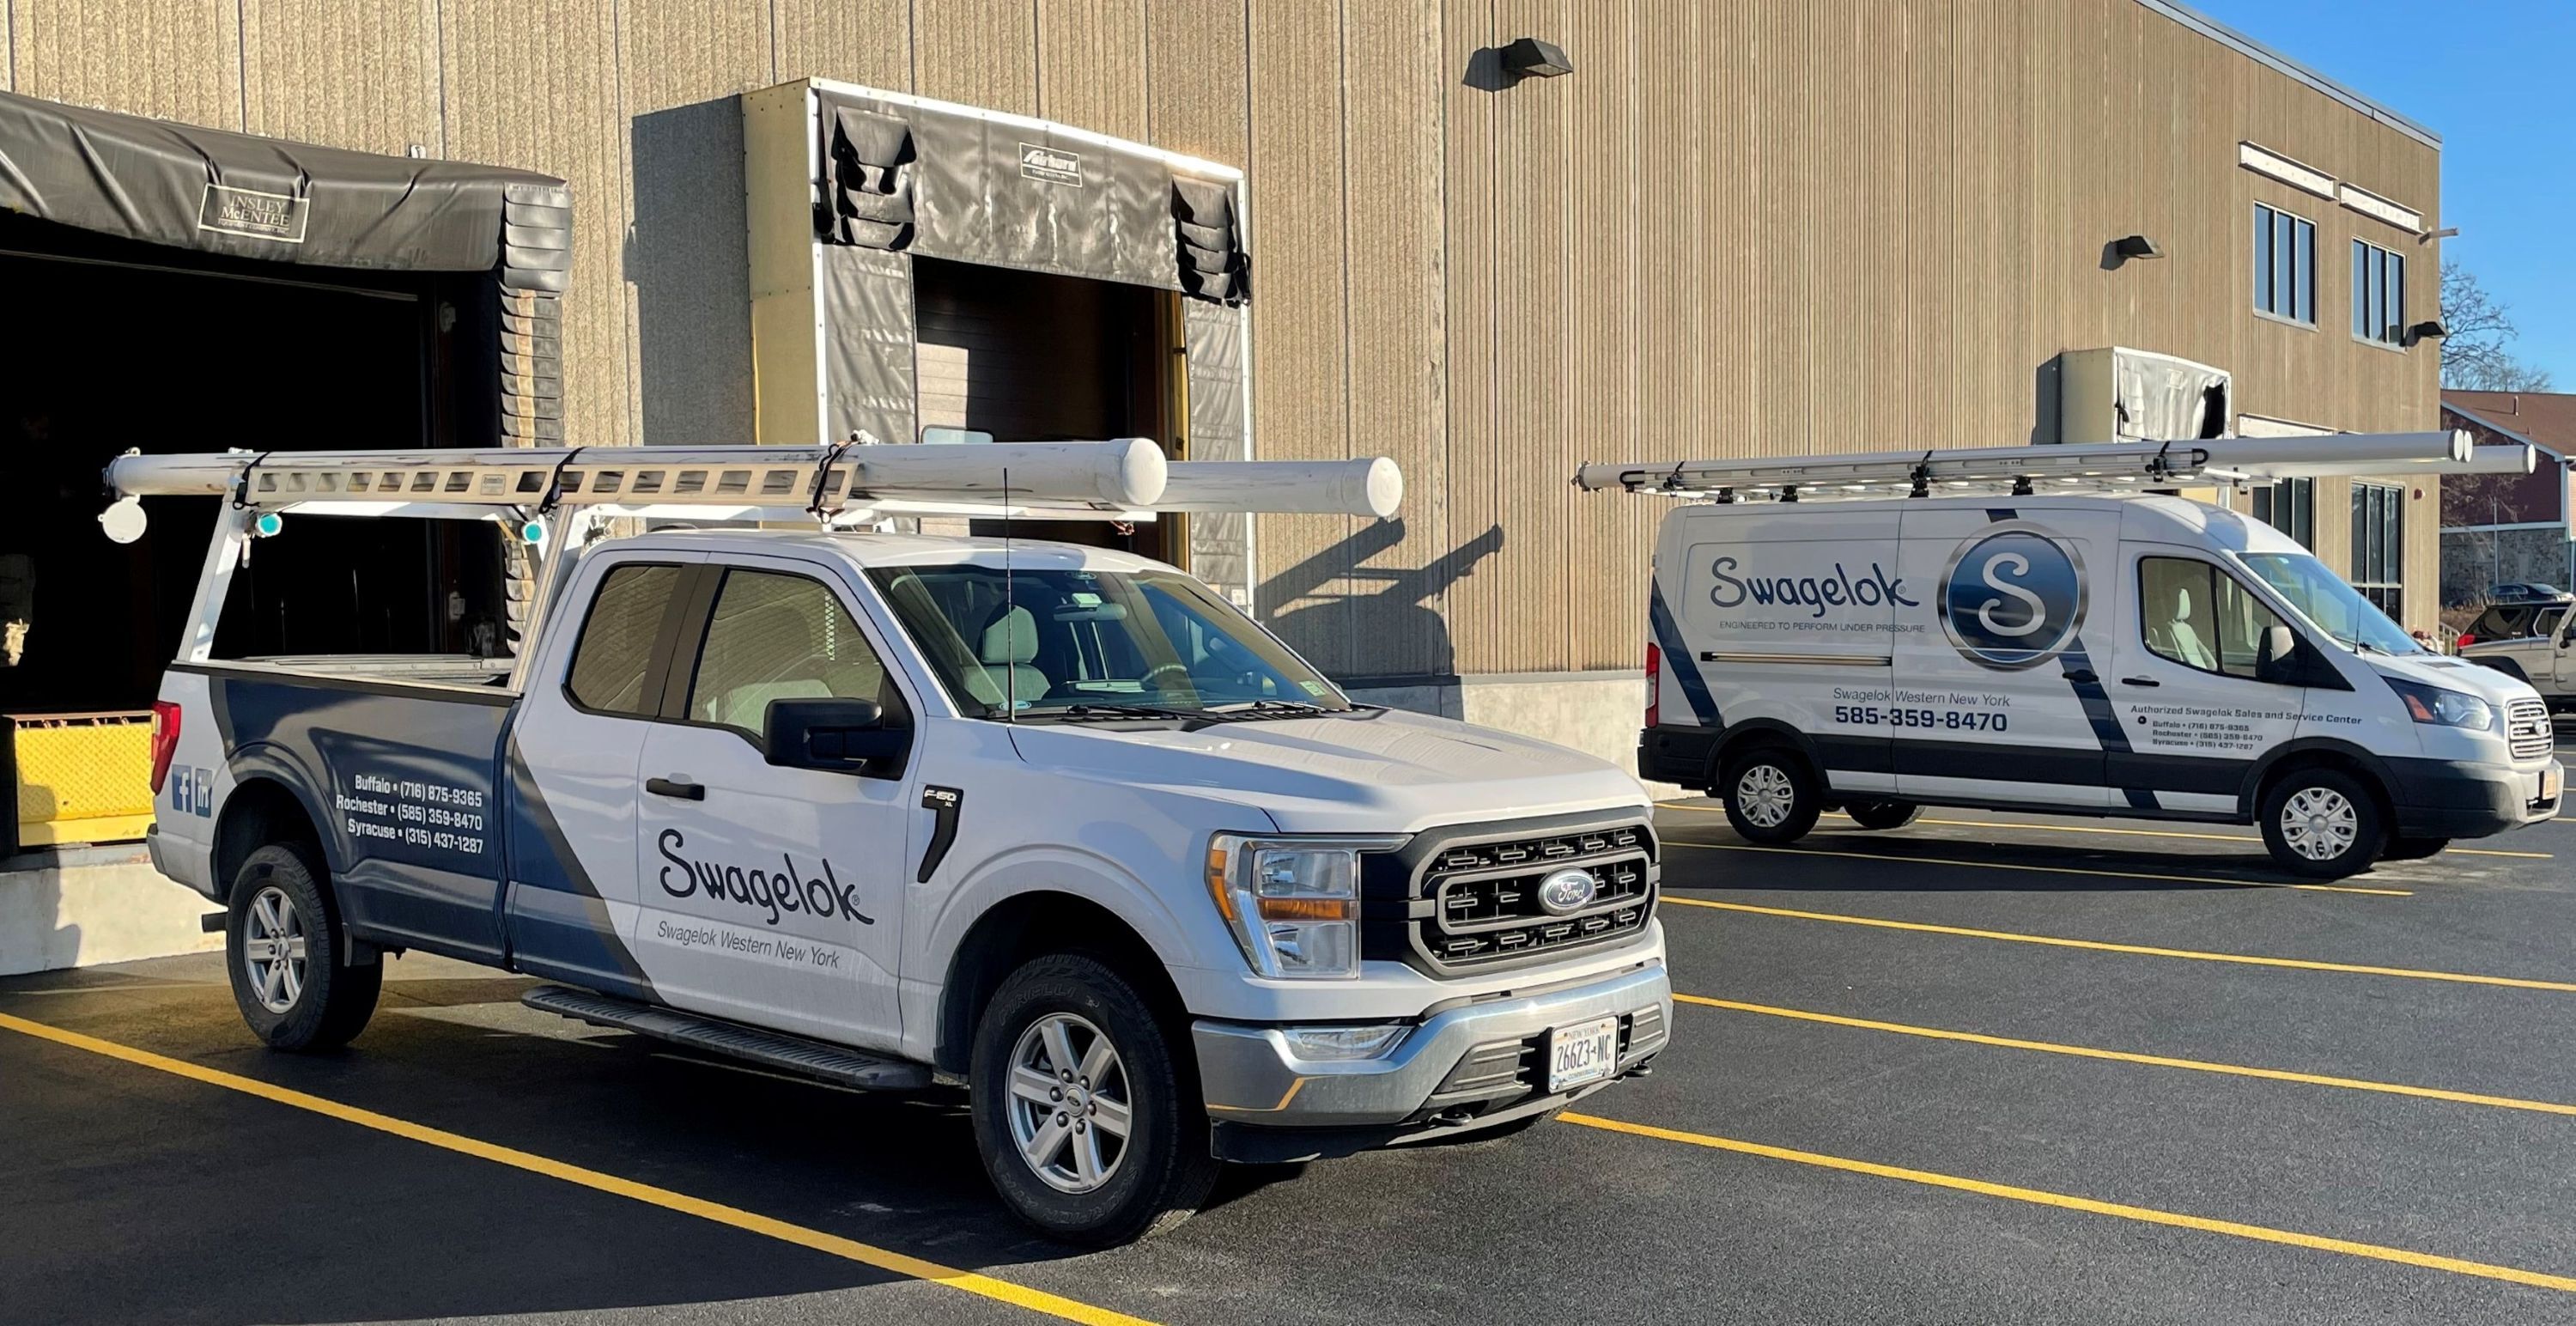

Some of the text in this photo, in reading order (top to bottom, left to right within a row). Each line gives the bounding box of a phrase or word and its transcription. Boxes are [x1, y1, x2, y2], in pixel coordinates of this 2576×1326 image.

[230, 195, 286, 213] INSLEY
[221, 206, 289, 226] McENTEE
[1978, 552, 2046, 636] S
[1719, 621, 1926, 633] ENGINEERED TO PERFORM UNDER PRESSURE
[1833, 687, 2011, 707] Swagelok Western New York
[1835, 706, 2008, 732] 585-359-8470
[2130, 705, 2363, 725] Authorized Swagelok Sales and Service Center
[2153, 721, 2181, 729] Buffalo
[355, 774, 483, 807] Buffalo (716) 875-9365
[924, 789, 957, 801] F-150
[336, 794, 483, 831] Rochester (585) 359-8470
[348, 818, 483, 854] Syracuse (315) 437-1287
[1558, 880, 1586, 903] Ford
[658, 921, 840, 969] Swagelok Western New York
[998, 983, 1077, 1026] PIRELLI
